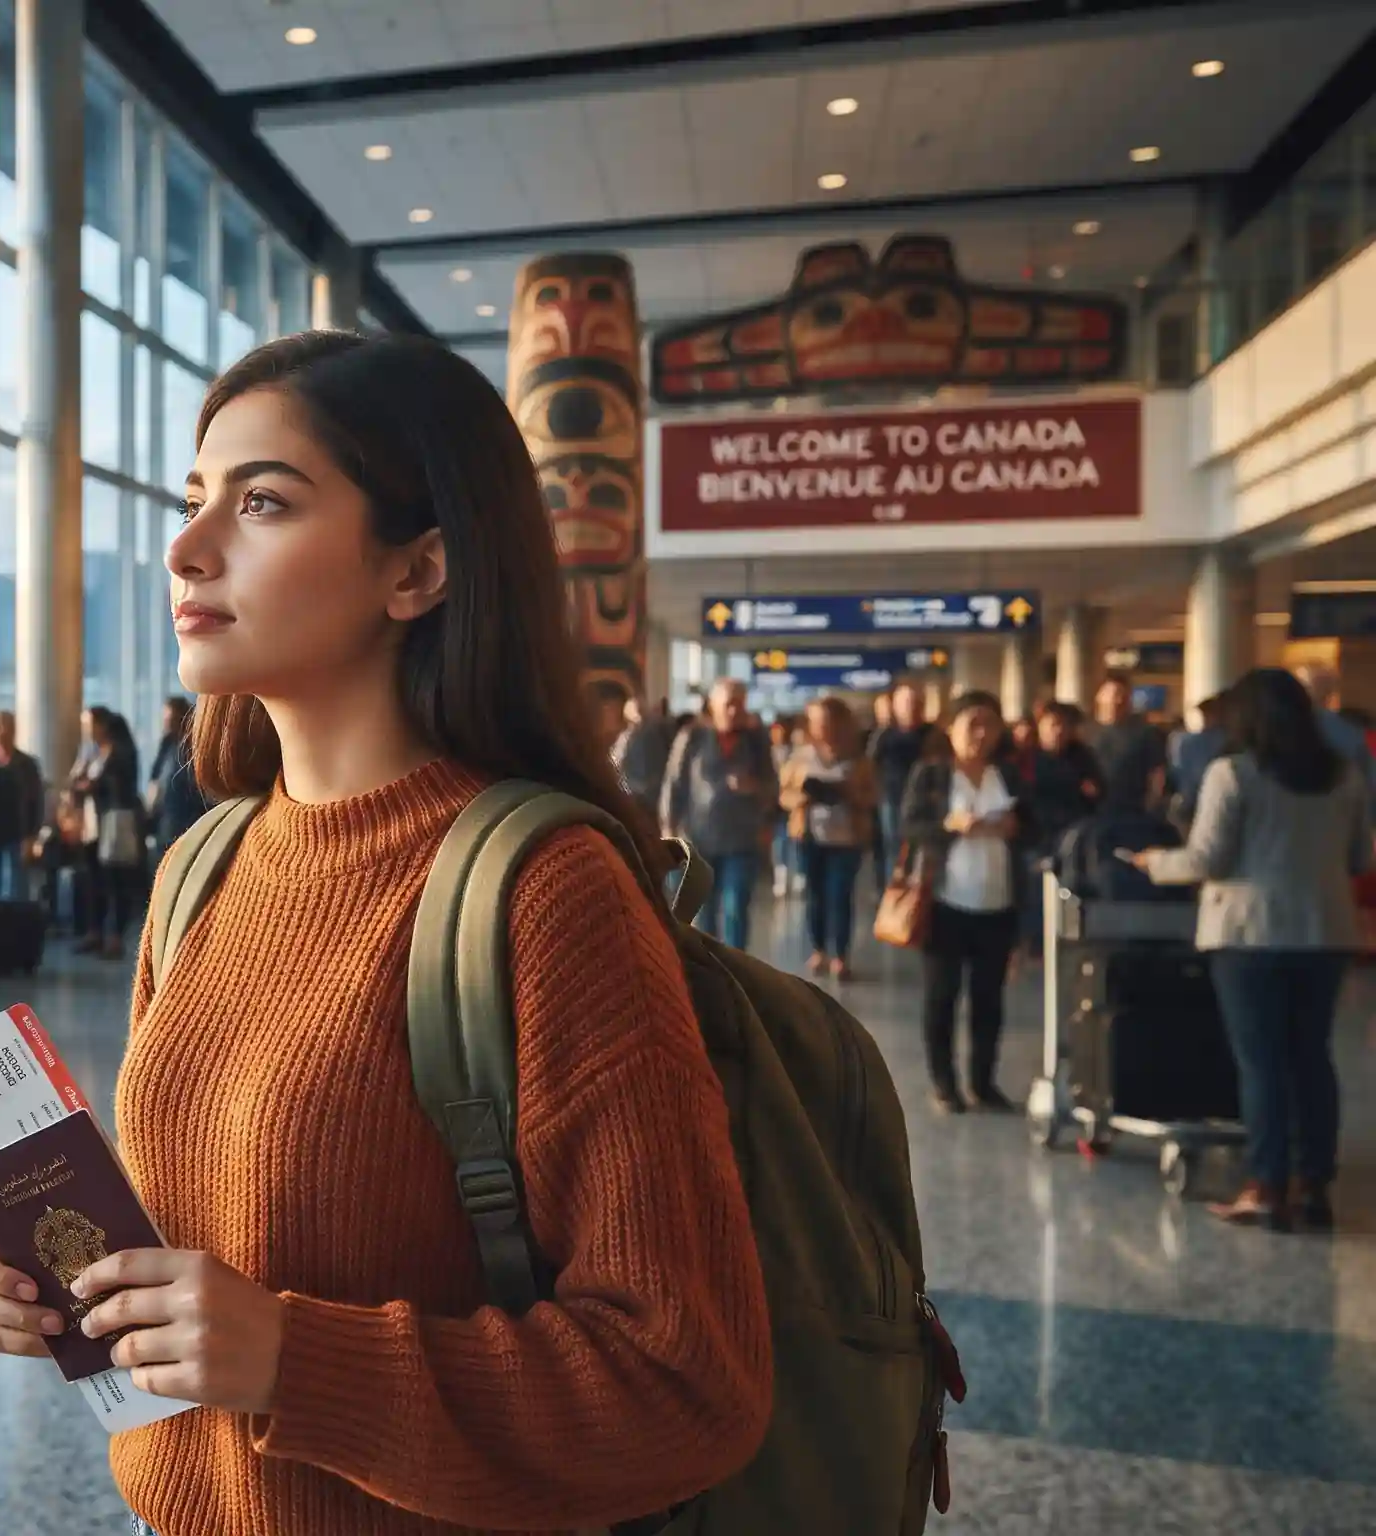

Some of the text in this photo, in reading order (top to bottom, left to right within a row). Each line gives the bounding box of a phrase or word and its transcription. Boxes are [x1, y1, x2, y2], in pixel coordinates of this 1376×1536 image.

[711, 417, 1086, 465] WELCOME TO CANADA
[697, 457, 1099, 503] BIENVENUE AU CANADA
